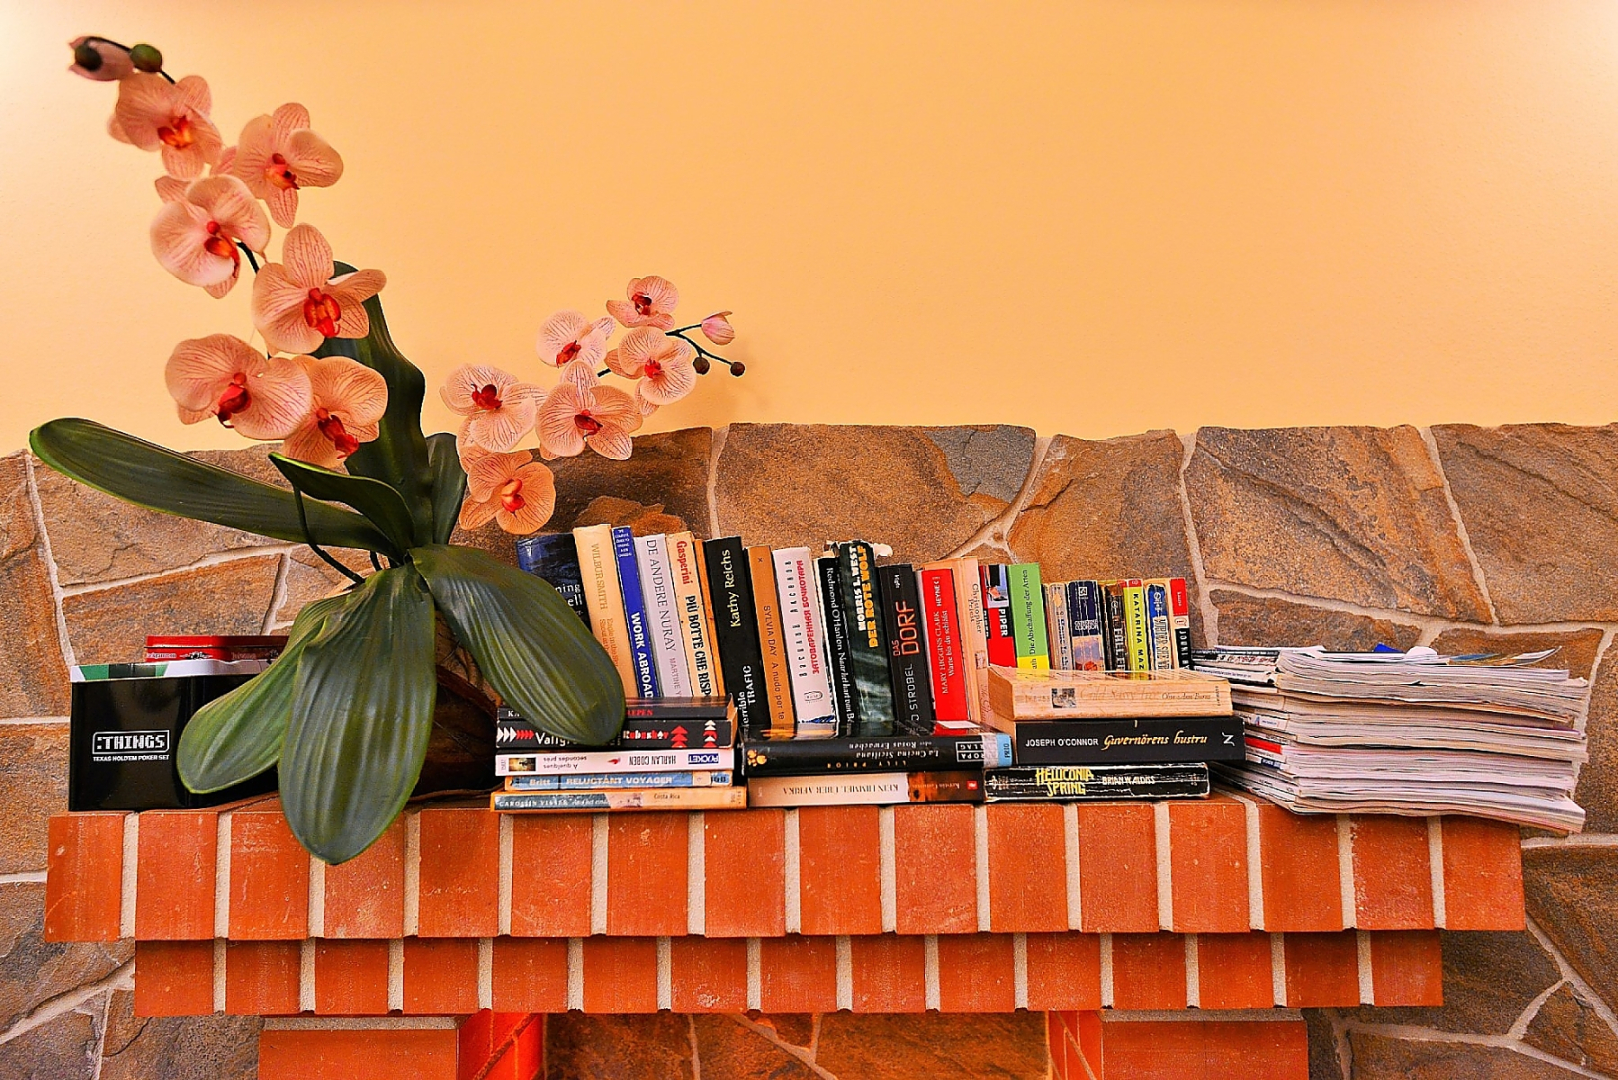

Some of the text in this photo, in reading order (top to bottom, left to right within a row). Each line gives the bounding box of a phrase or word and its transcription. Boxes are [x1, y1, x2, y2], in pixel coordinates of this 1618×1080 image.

[676, 540, 693, 585] Gasperini
[849, 546, 860, 577] WEST
[590, 543, 608, 610] WILBUR SMITH
[647, 539, 677, 652] DE ANDERE NURAY
[721, 549, 742, 628] Kathy Reichs
[826, 567, 839, 609] Redmond
[857, 545, 879, 648] DER ROTE WOLF
[796, 560, 820, 675] ЗАТОВАРЕННАЯ БОЧКОТАРА
[972, 583, 983, 634] Christopher
[763, 605, 778, 657] SYLVIA DAY
[832, 608, 843, 651] O'Hanlon
[895, 600, 920, 656] DORF
[998, 608, 1008, 637] PIPER
[1026, 601, 1035, 642] Abschaffung
[1133, 593, 1145, 670] KATARINA MAZ
[630, 611, 654, 698] WORK ABROAD
[685, 595, 712, 697] PIÙ BOTTE CHE RISP
[892, 640, 901, 657] DAS
[934, 611, 949, 695] MARY HIGGINS CLARK
[1029, 641, 1037, 656] Die
[947, 657, 956, 677] Warte
[743, 665, 756, 704] TRAFIC
[772, 671, 782, 692] nudo
[905, 663, 919, 711] STROBEL
[775, 694, 784, 709] per
[848, 741, 890, 752] Erwachen
[892, 740, 917, 750] Rosas
[959, 742, 983, 750] RLAG
[1025, 736, 1099, 748] JOSEPH O'CONNOR
[1101, 730, 1209, 751] Guvernörens hustru
[93, 755, 112, 763] TEXAS
[138, 754, 158, 762] POKER
[559, 755, 588, 764] secondes
[629, 754, 677, 767] HARLAN COBEN
[688, 753, 719, 765] POCKET
[855, 749, 939, 760] La Cucina Siciliana
[960, 752, 984, 760] ROPA
[543, 761, 571, 771] quelques
[826, 760, 907, 769] LILY PRIOR
[528, 777, 551, 787] Britt
[565, 775, 673, 786] RELUCTANT VOYAGER
[938, 781, 960, 790] Kerstin
[1035, 767, 1095, 786] HELLICONIA
[1102, 775, 1124, 786] BRIAN
[1132, 775, 1156, 785] ALDISS
[653, 792, 669, 801] Costa
[782, 783, 899, 796] KEIN HIMMEL ÜBER AFRIKA
[1046, 781, 1087, 797] SPRING
